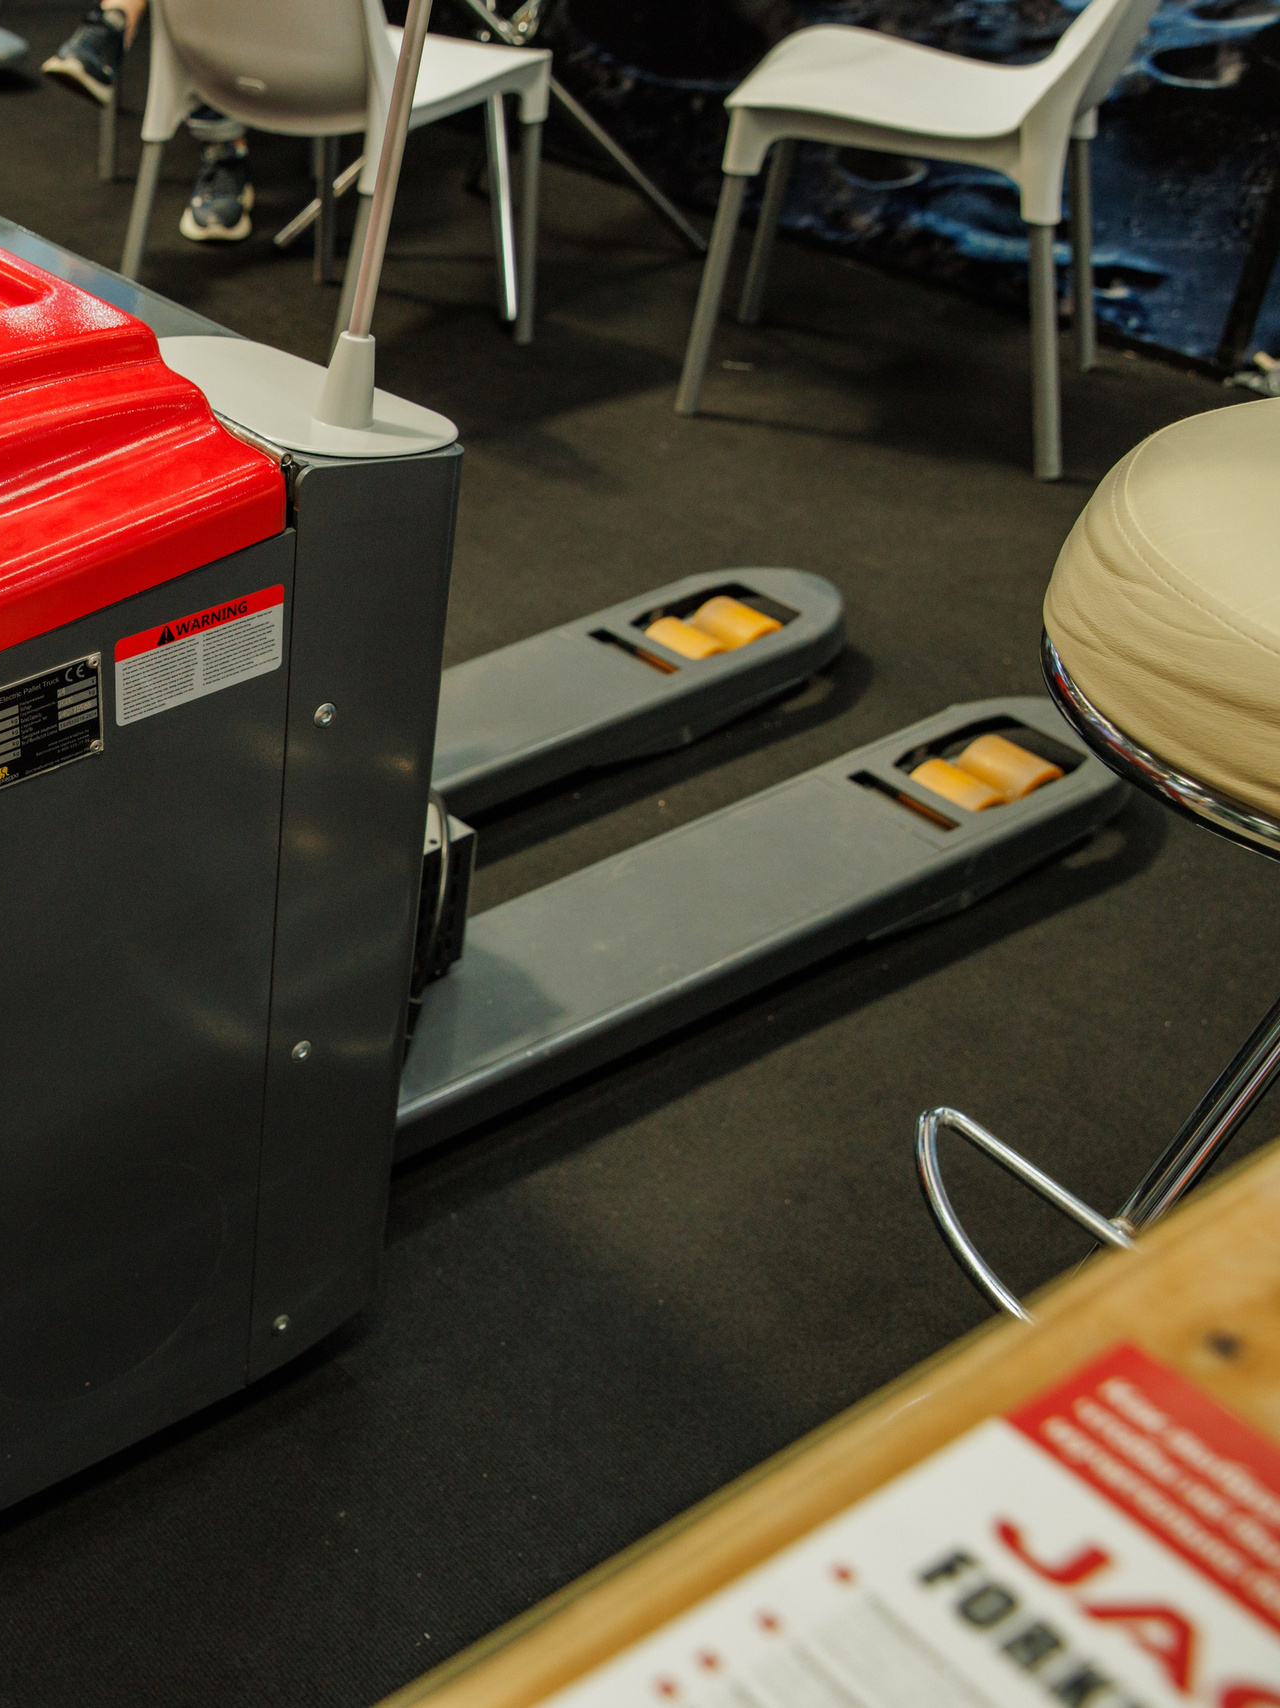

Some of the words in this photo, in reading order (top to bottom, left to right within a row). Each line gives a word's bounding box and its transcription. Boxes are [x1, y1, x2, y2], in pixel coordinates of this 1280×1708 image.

[175, 601, 247, 635] WARNING
[23, 683, 41, 695] Pallet
[42, 677, 59, 687] Truck
[88, 688, 95, 696] kg
[10, 717, 18, 725] kg
[11, 728, 18, 736] kg
[12, 739, 19, 747] kg
[12, 750, 19, 758] kg
